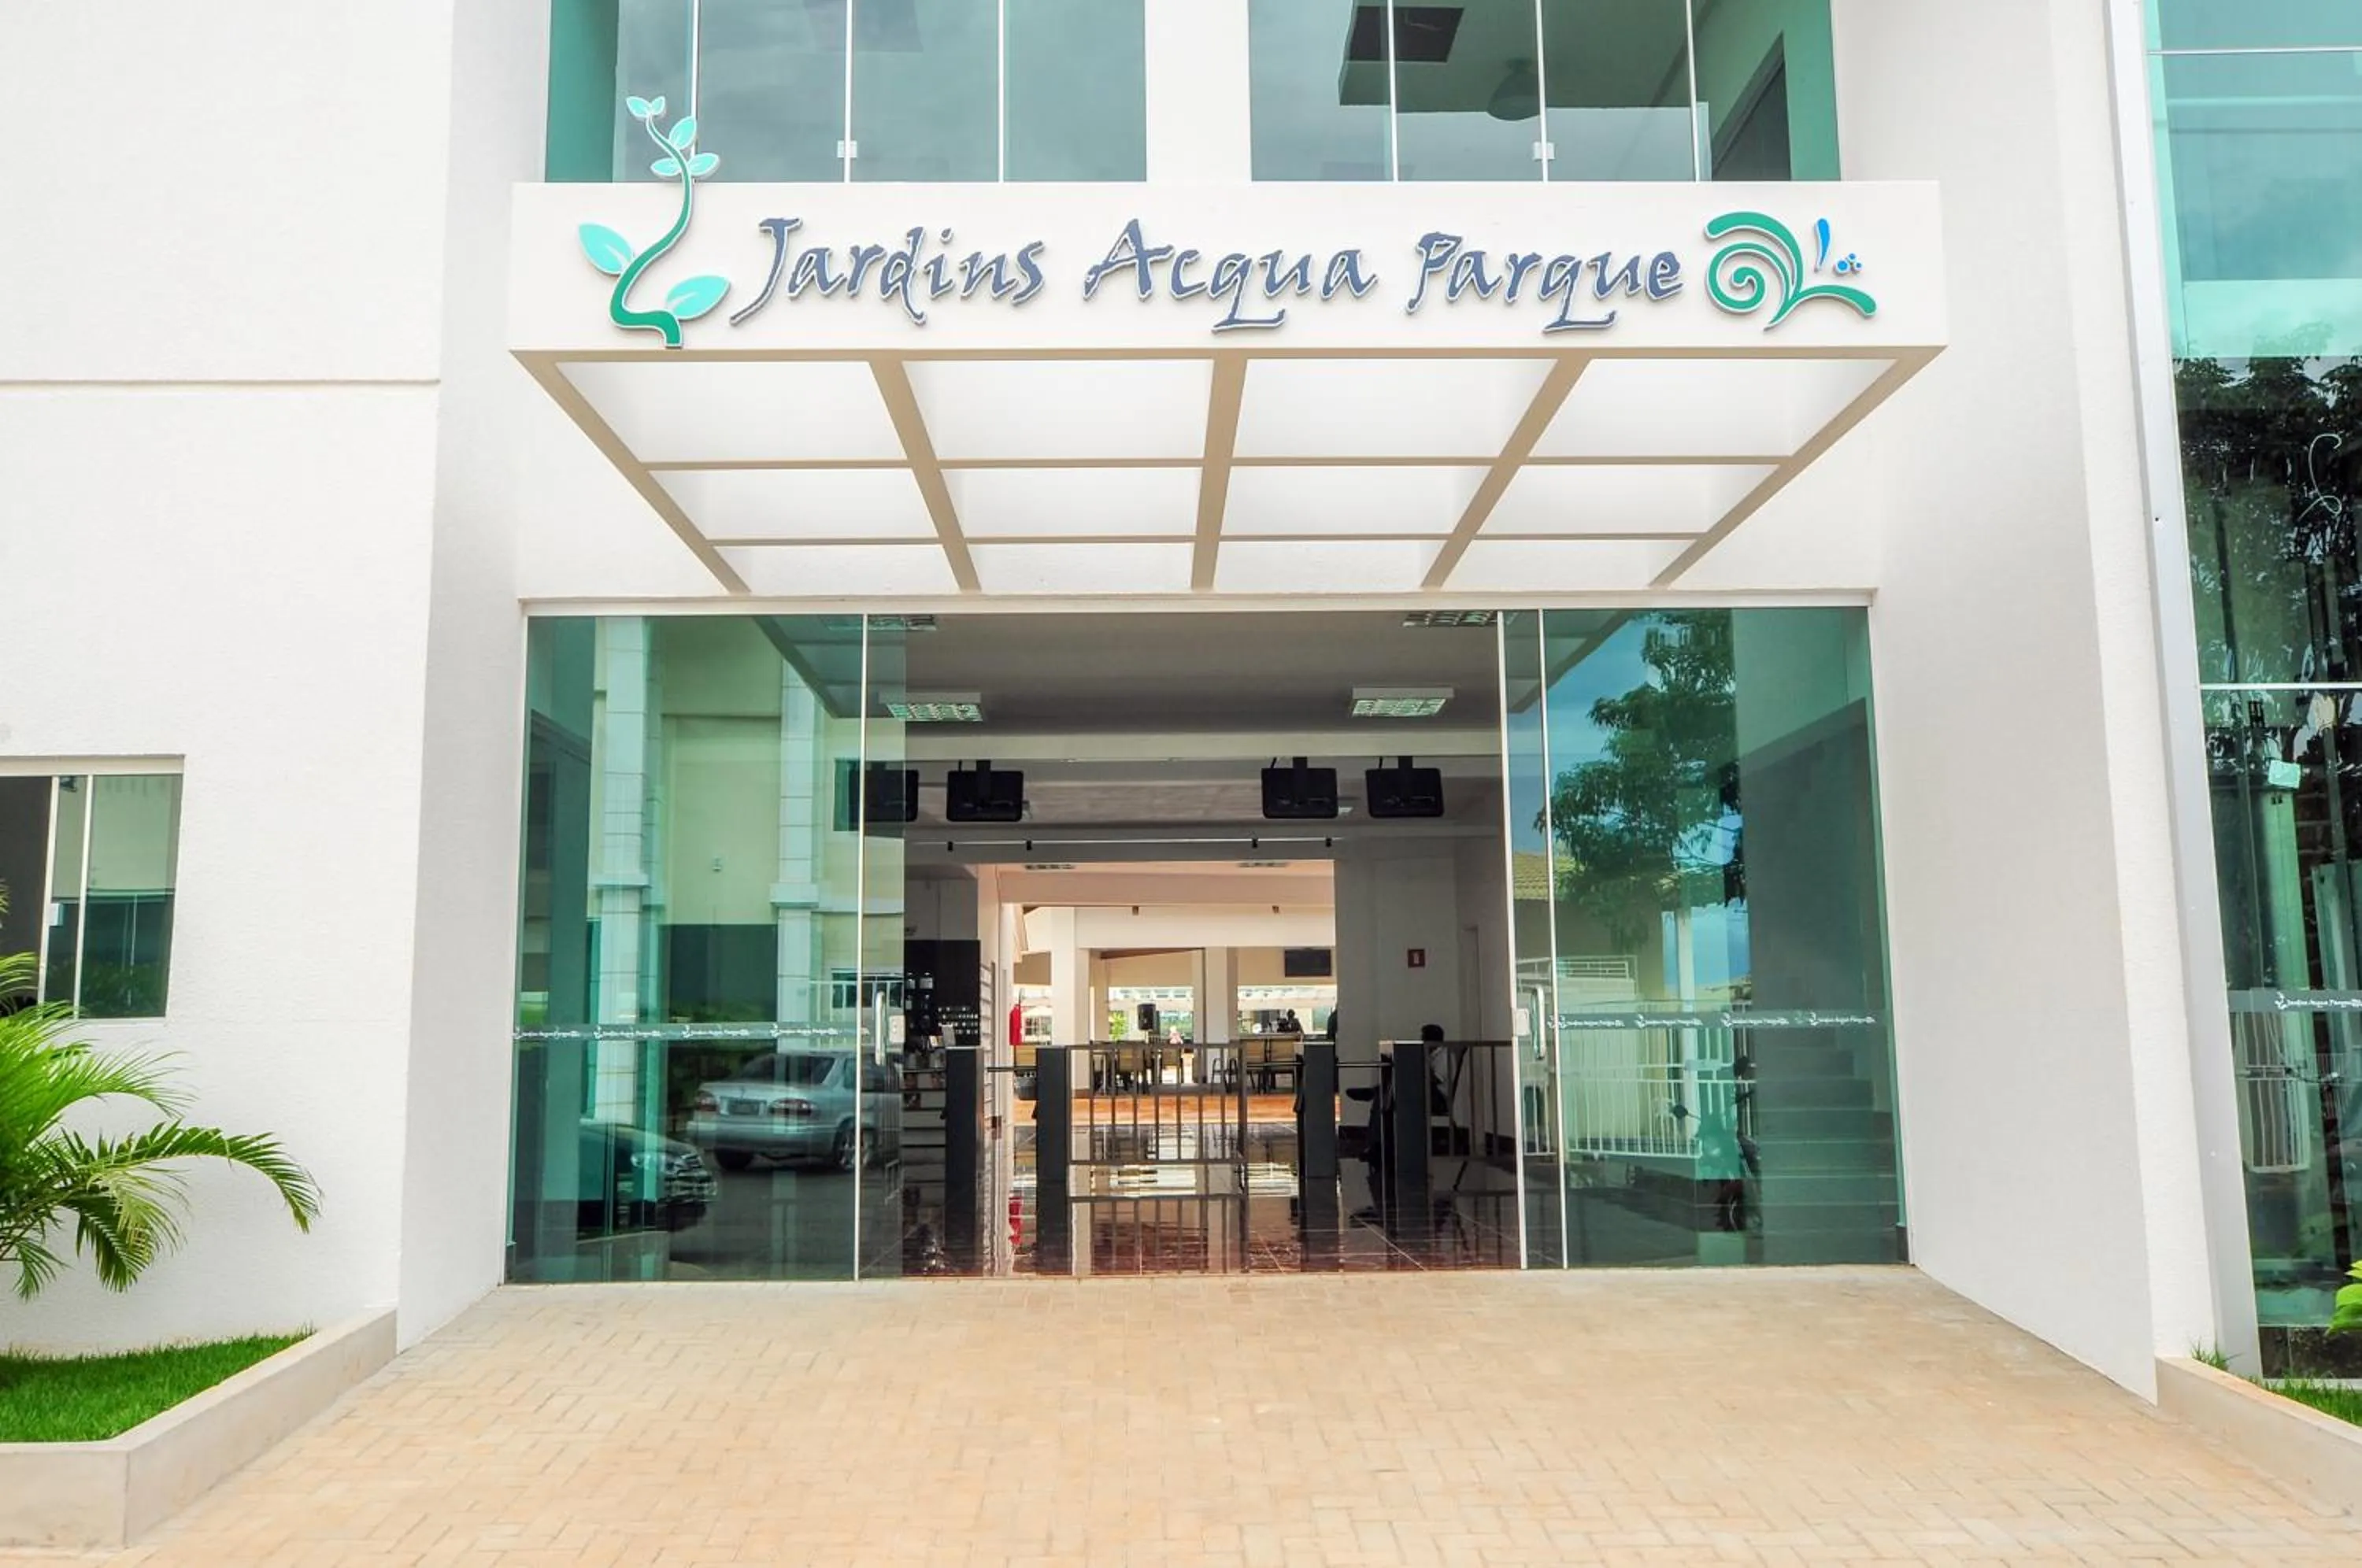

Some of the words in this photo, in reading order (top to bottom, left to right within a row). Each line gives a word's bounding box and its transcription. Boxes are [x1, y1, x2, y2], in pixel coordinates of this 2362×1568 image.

[730, 217, 1045, 326] Jardins
[1083, 218, 1377, 333] Acqua
[1406, 231, 1684, 334] Parque
